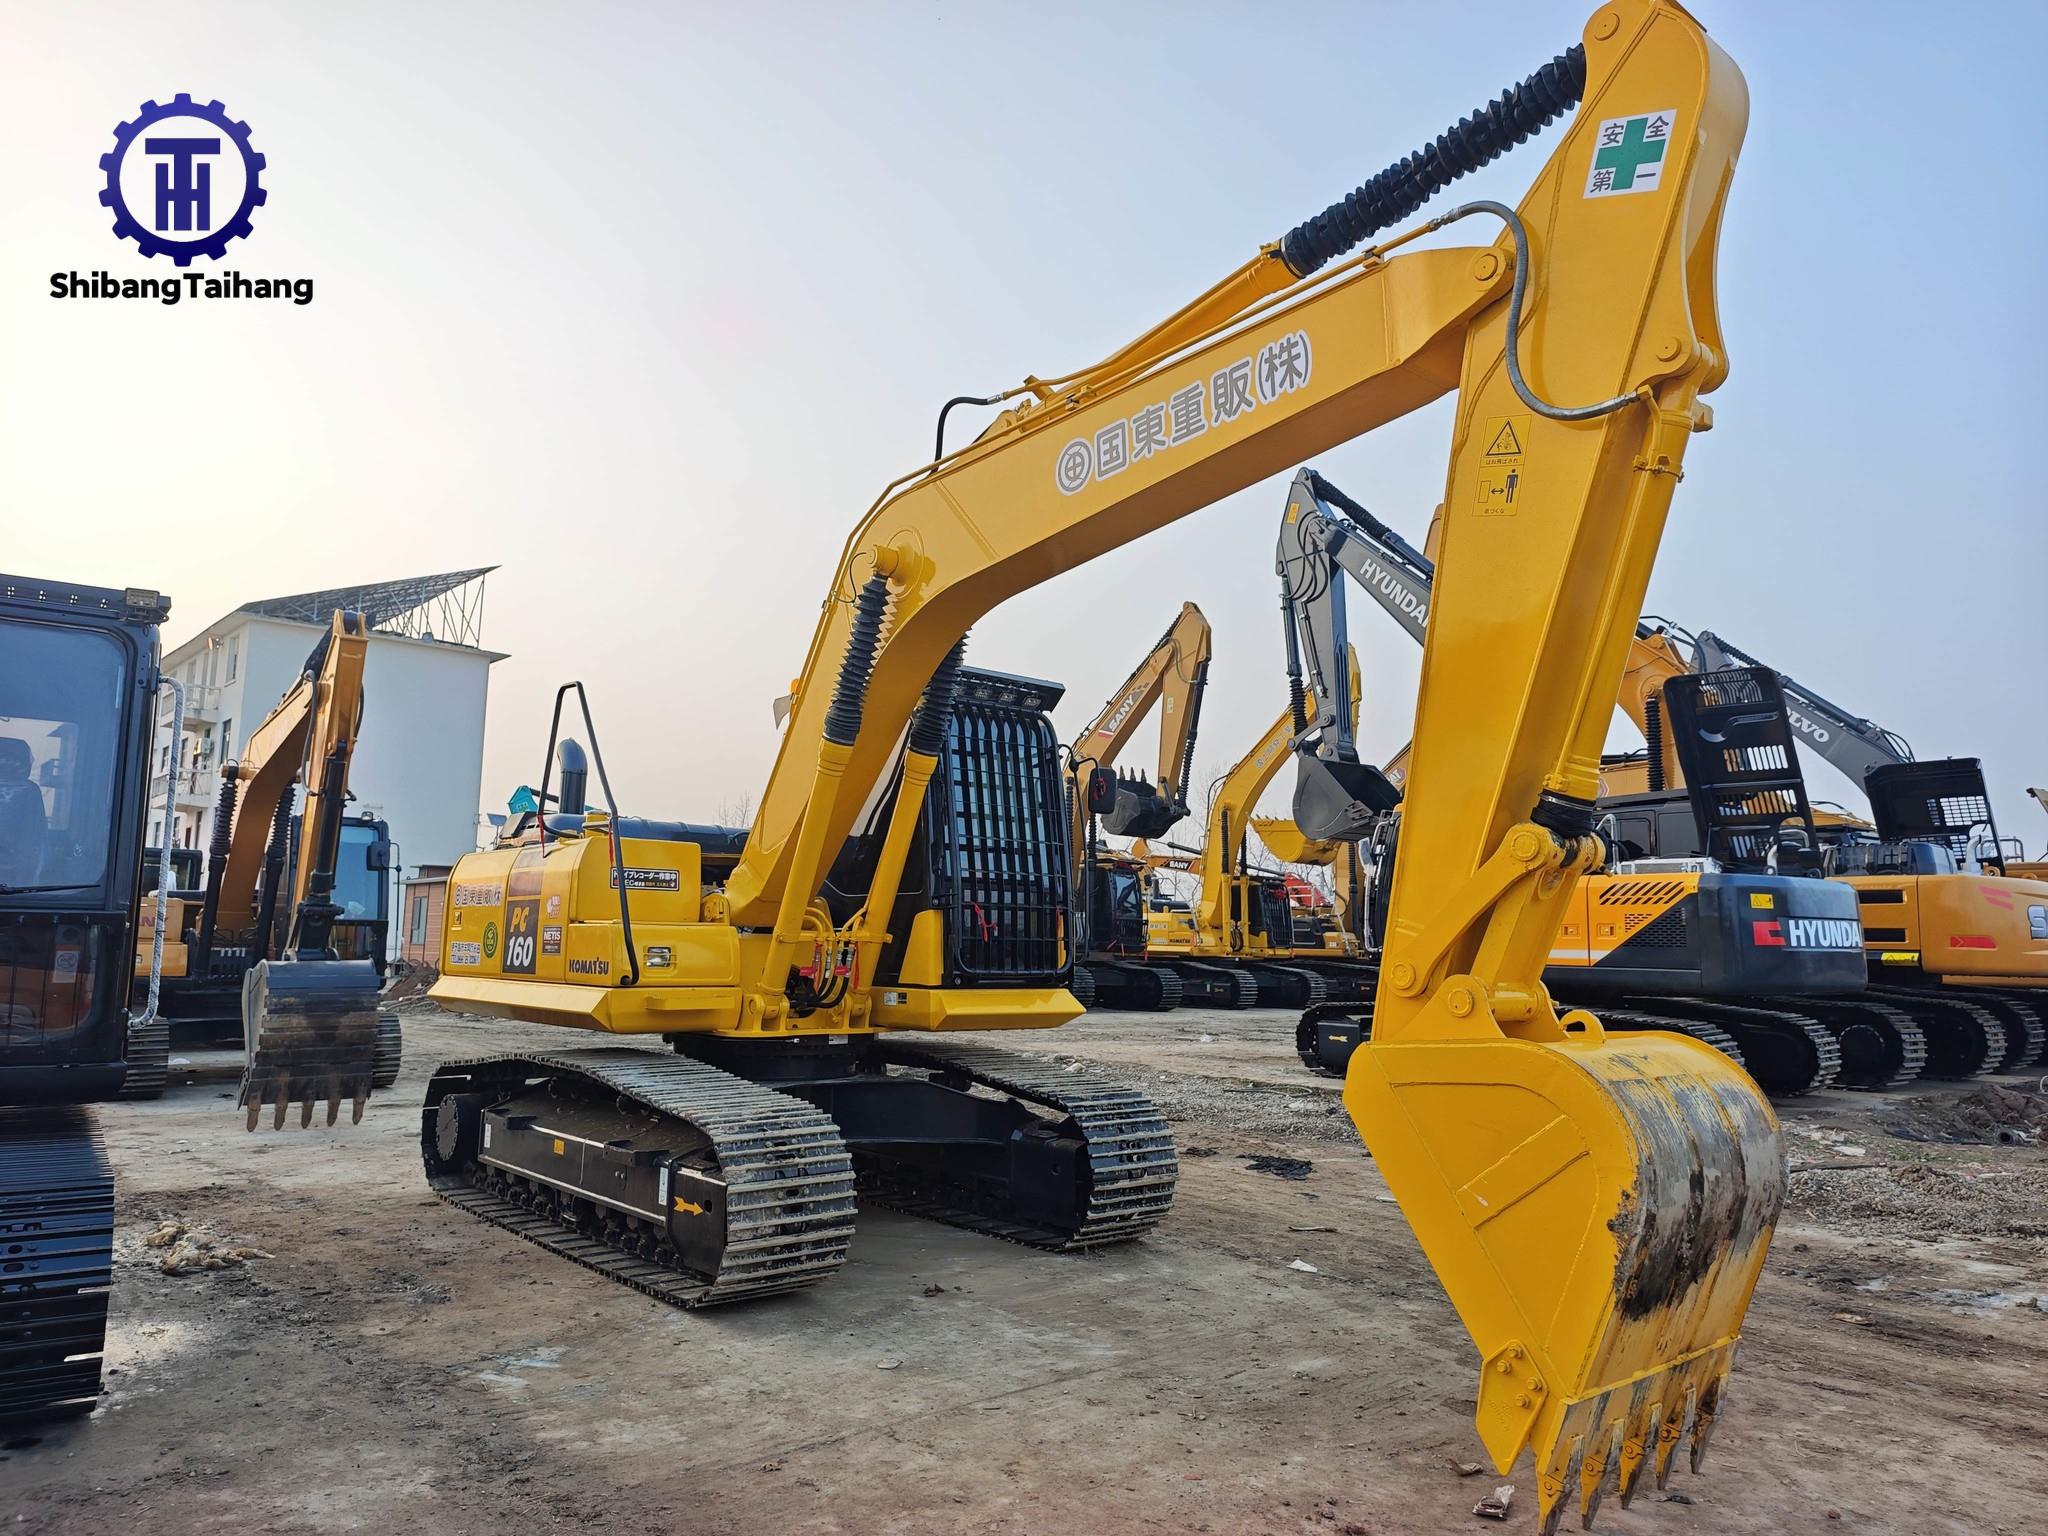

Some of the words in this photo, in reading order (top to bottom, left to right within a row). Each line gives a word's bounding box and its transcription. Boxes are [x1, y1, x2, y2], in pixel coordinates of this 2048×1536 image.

[1108, 694, 1135, 732] SANY
[1786, 706, 1829, 743] LVO
[1169, 860, 1190, 870] SANY
[510, 906, 530, 933] PC
[543, 931, 561, 941] NETIS
[506, 936, 534, 968] 160
[569, 957, 609, 976] KOMATSU
